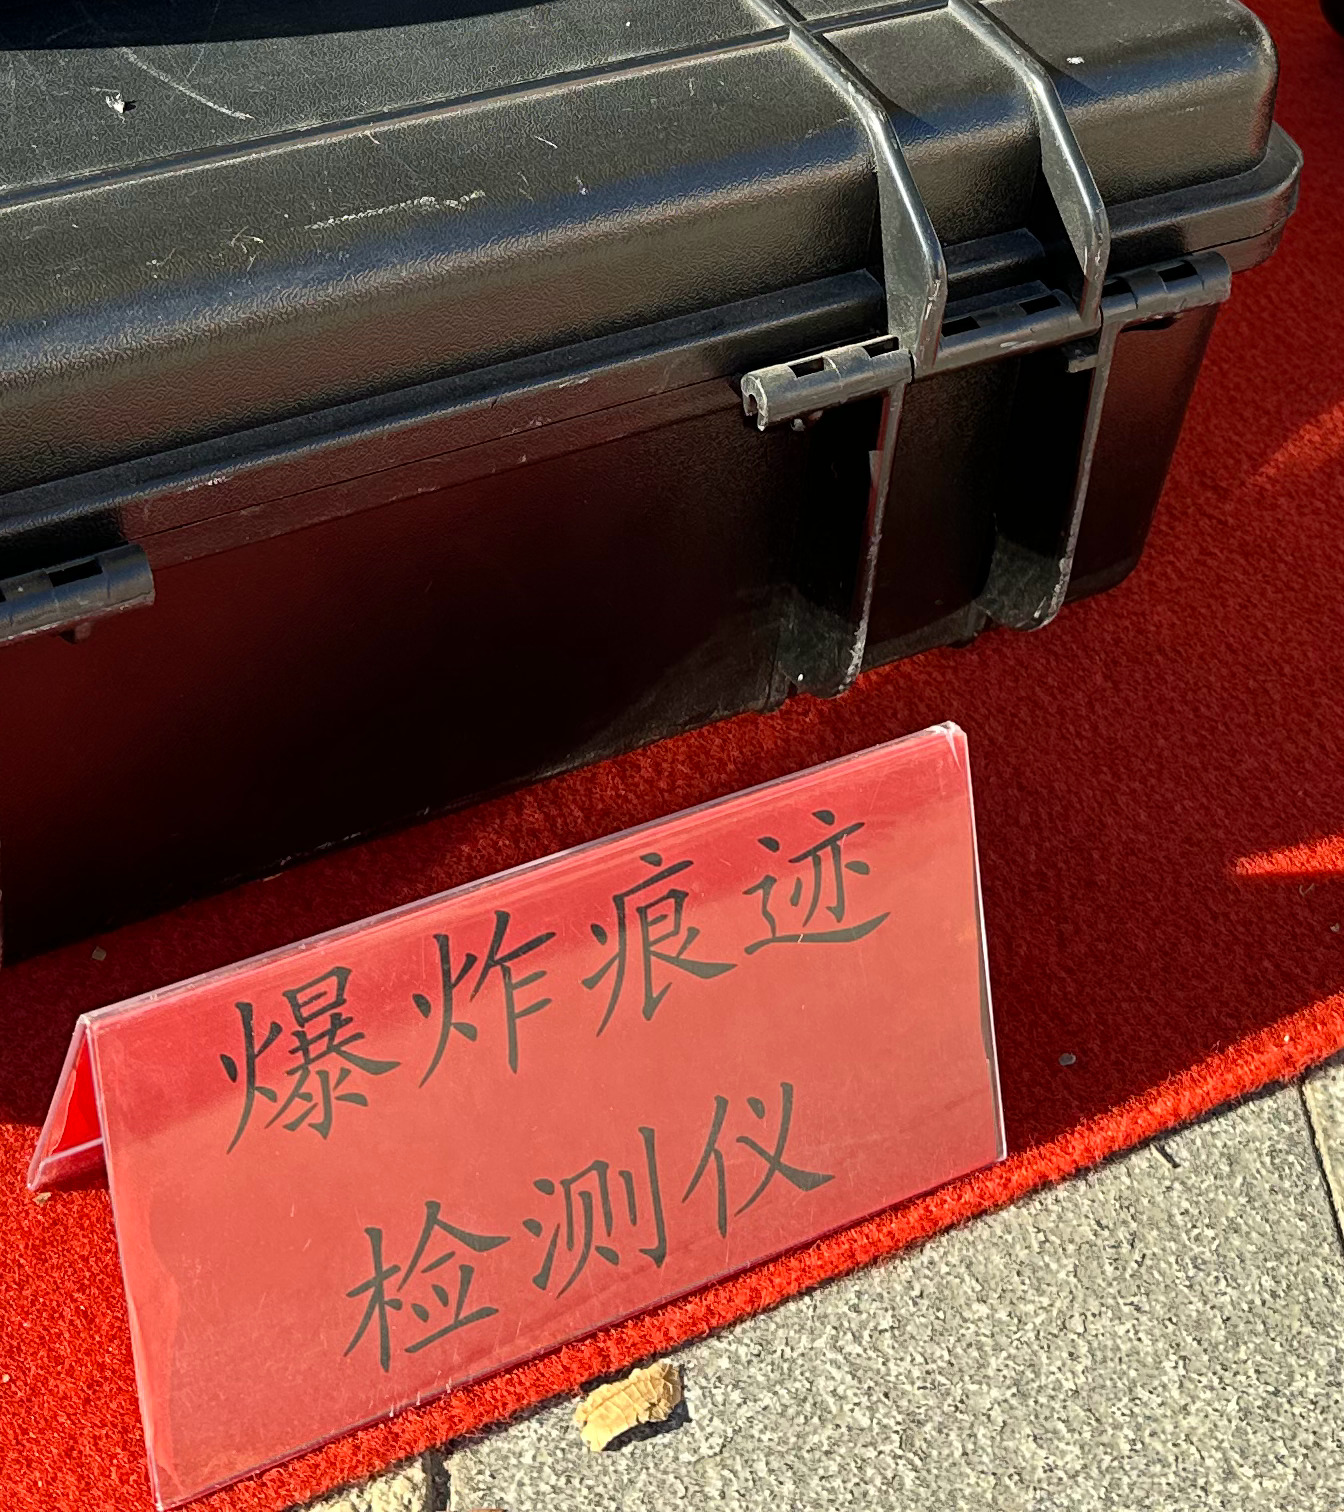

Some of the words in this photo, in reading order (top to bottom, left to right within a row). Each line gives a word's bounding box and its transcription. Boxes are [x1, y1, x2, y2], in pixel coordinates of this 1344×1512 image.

[218, 809, 891, 1154] 爆炸痕迹
[344, 1081, 836, 1373] 检测仪
